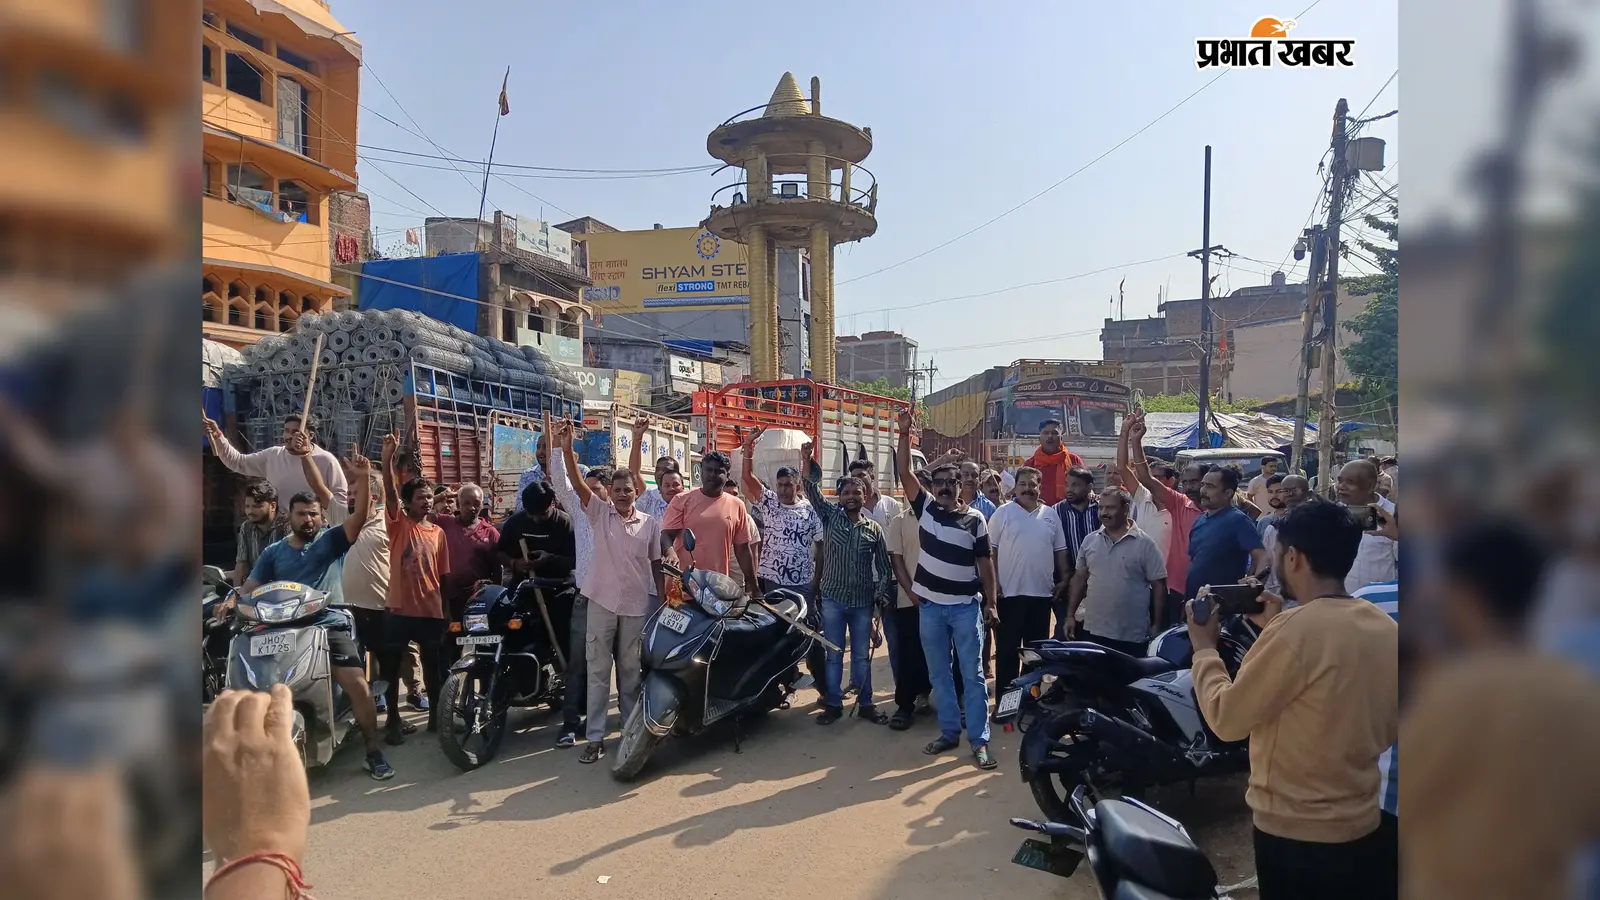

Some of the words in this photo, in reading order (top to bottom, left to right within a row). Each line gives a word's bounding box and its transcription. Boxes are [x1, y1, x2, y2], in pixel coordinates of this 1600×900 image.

[642, 264, 705, 280] SHYAM
[712, 263, 747, 277] STE
[657, 284, 676, 293] flexi
[677, 281, 714, 292] STRONG
[716, 281, 732, 290] TMT
[667, 611, 685, 621] JH07
[662, 617, 684, 632] L6318
[261, 635, 286, 645] JH07
[258, 643, 290, 655] K1725
